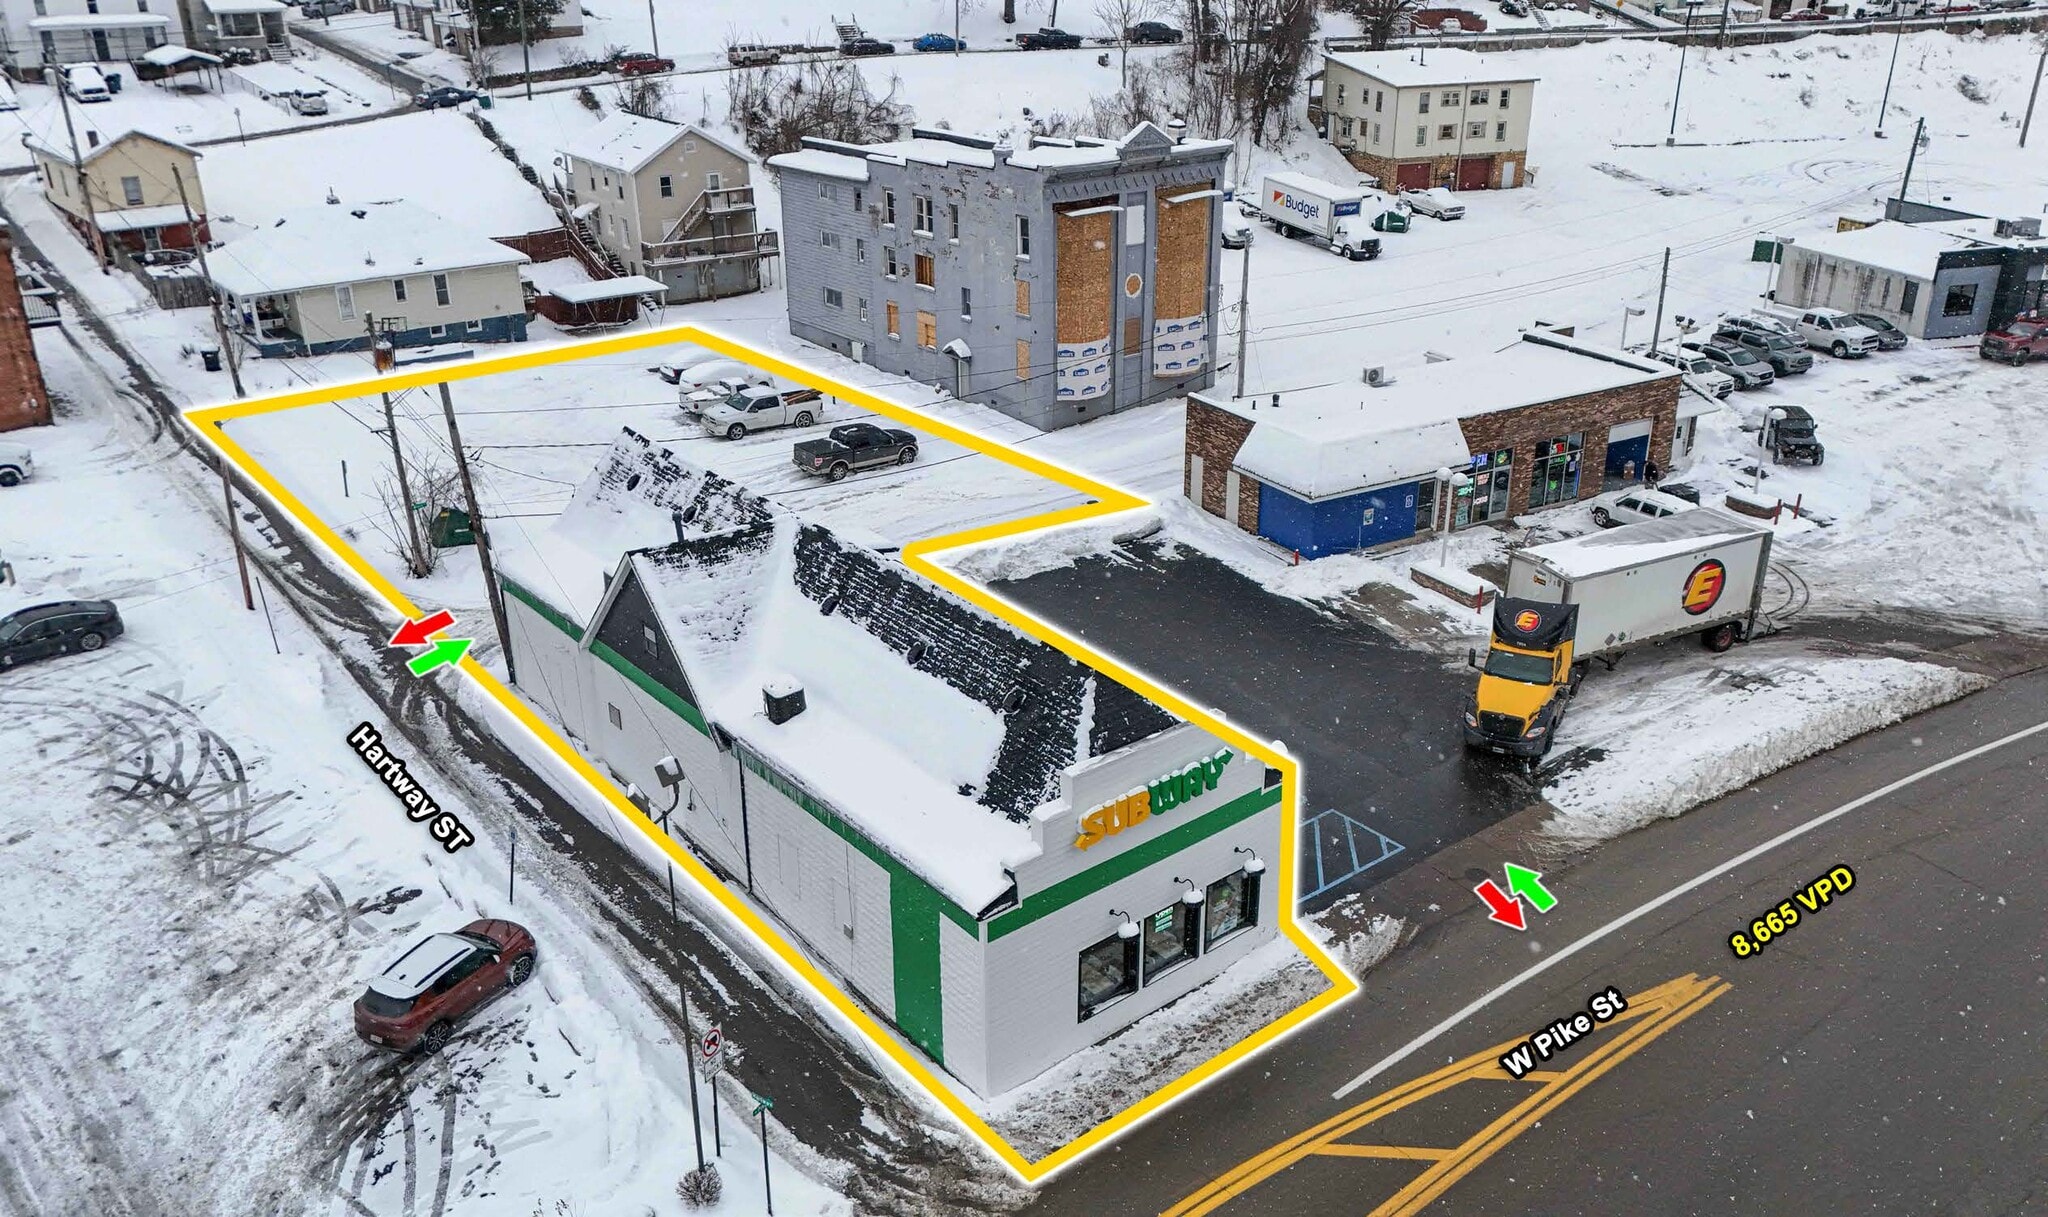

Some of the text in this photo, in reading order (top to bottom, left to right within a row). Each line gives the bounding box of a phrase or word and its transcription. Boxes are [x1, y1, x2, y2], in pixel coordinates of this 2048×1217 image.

[1286, 195, 1319, 218] Budget
[1683, 568, 1722, 607] E
[1074, 746, 1234, 851] SUBWAY
